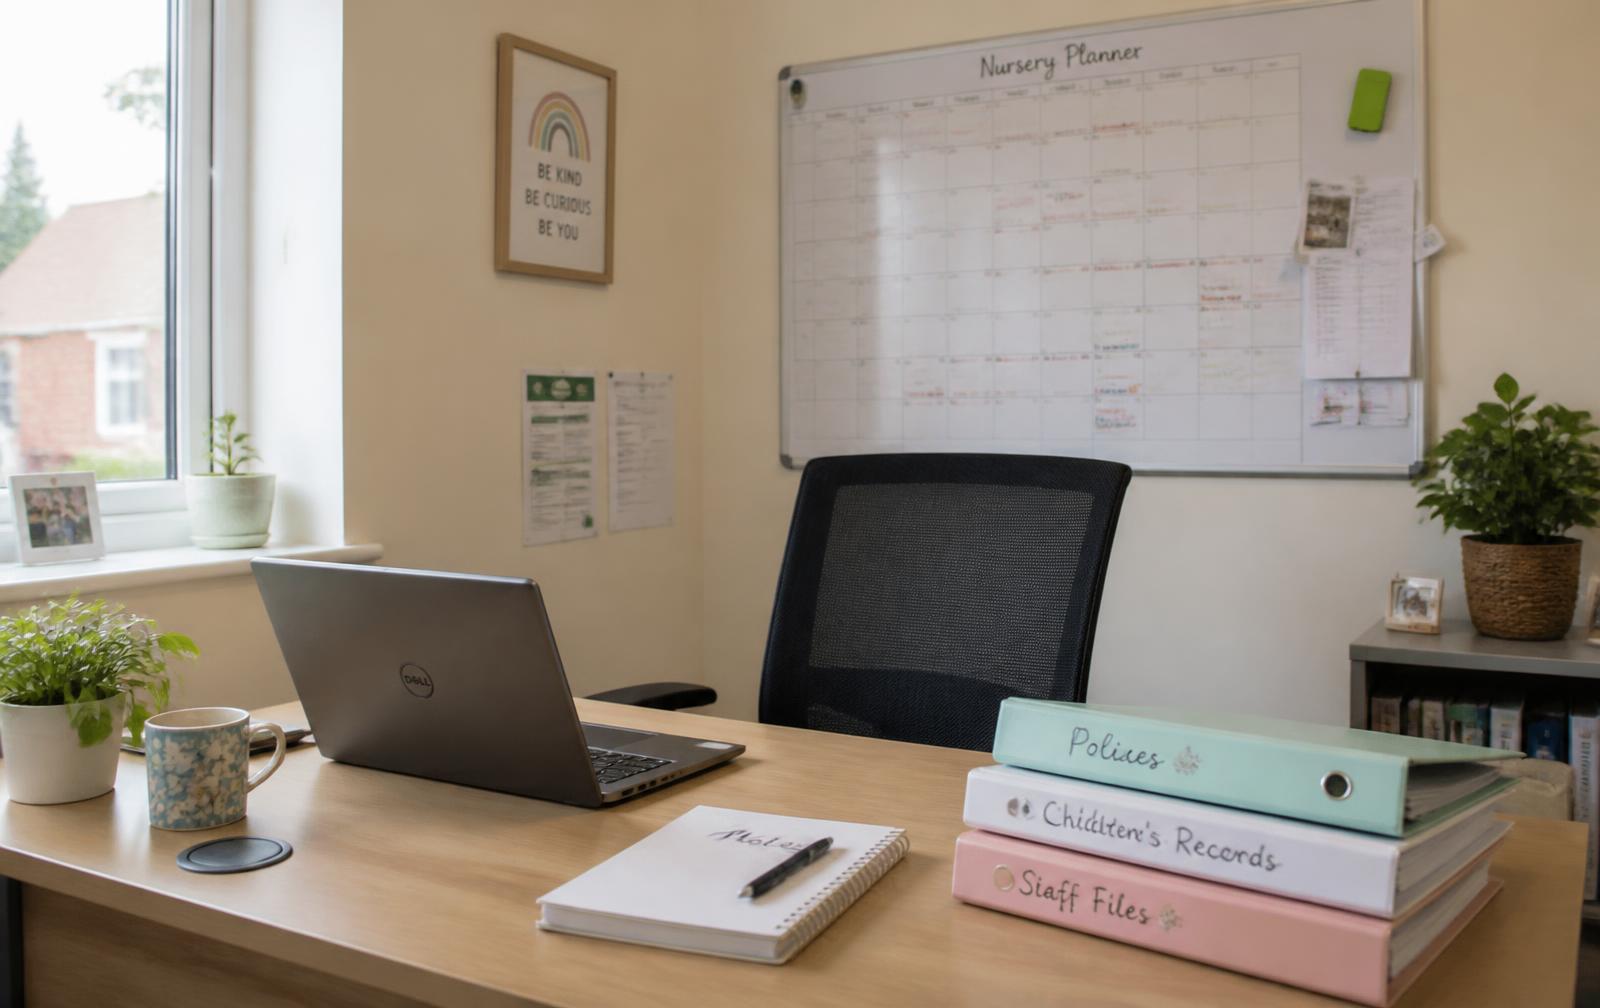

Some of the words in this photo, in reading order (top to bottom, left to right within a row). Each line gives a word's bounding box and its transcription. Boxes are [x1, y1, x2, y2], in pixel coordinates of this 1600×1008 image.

[980, 54, 1055, 80] Nursery
[1064, 42, 1143, 68] Planner
[537, 162, 551, 181] BE
[556, 166, 583, 187] KIND
[525, 188, 539, 206] BE
[543, 191, 592, 216] CURIOUS
[538, 218, 553, 237] BE
[556, 222, 579, 241] YOU
[1093, 885, 1151, 926] Files
